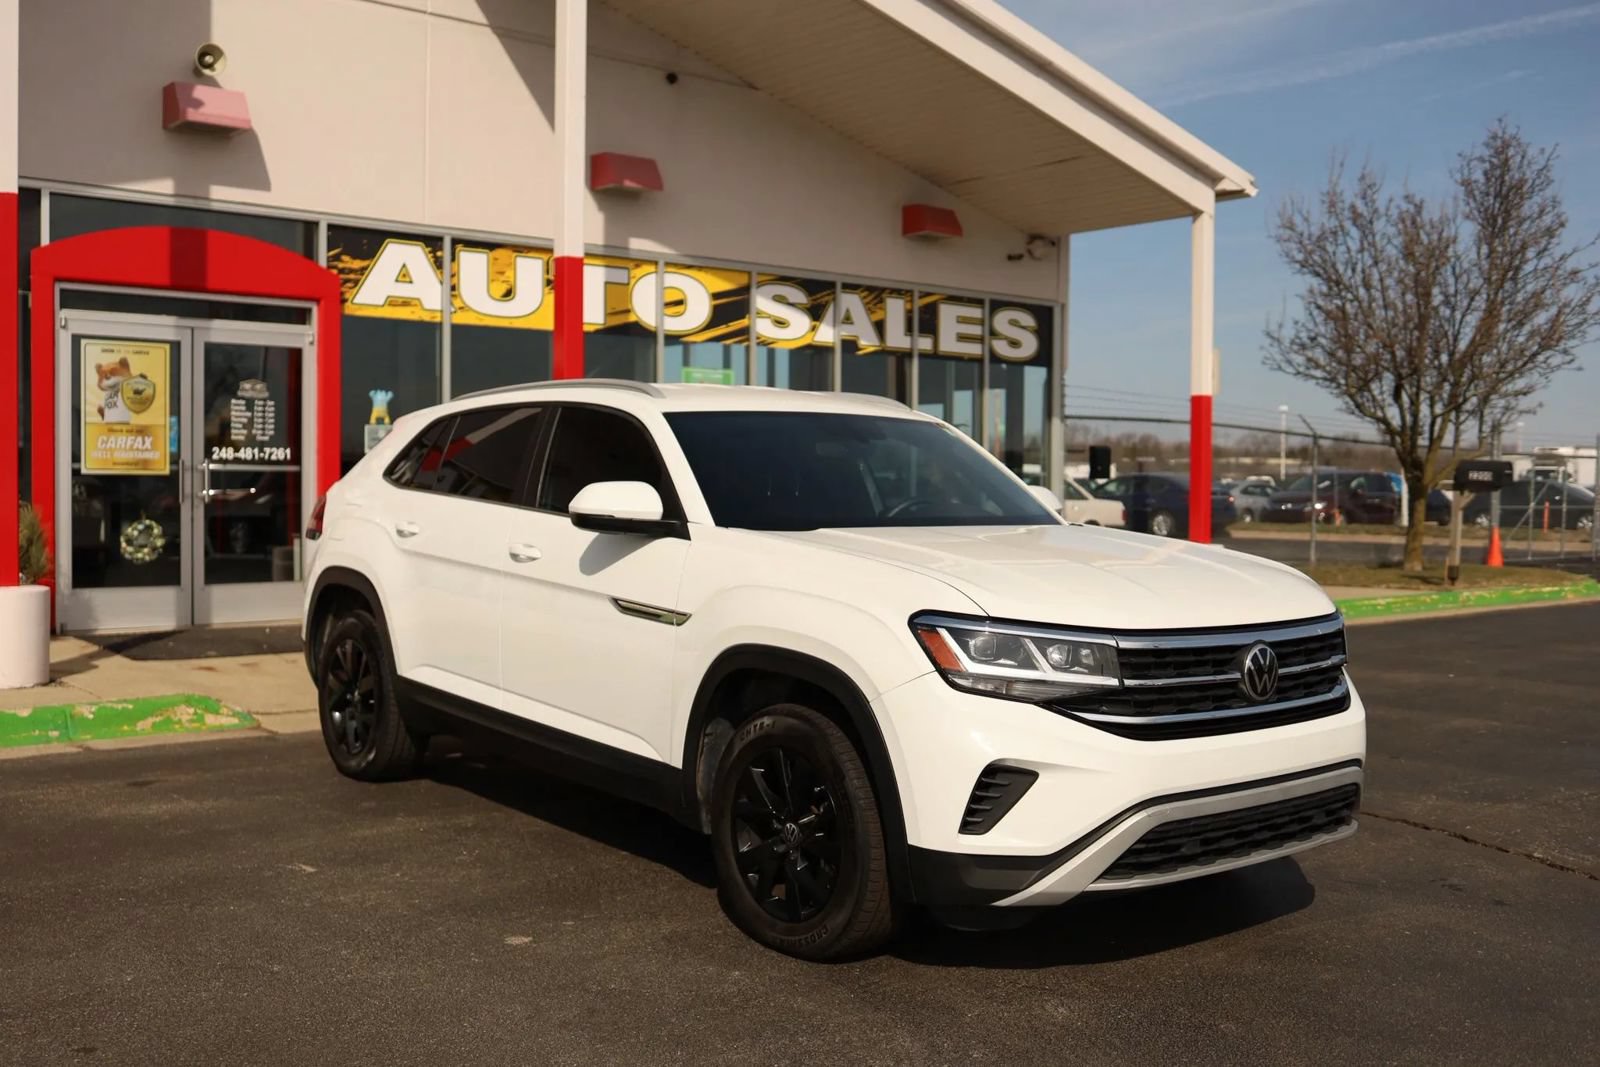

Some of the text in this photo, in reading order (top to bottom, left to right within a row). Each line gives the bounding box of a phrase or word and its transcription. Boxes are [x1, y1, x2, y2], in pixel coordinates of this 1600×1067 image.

[350, 239, 1039, 362] AUTO SALES
[97, 435, 153, 450] CARFAX
[211, 446, 291, 461] 248-481-7261
